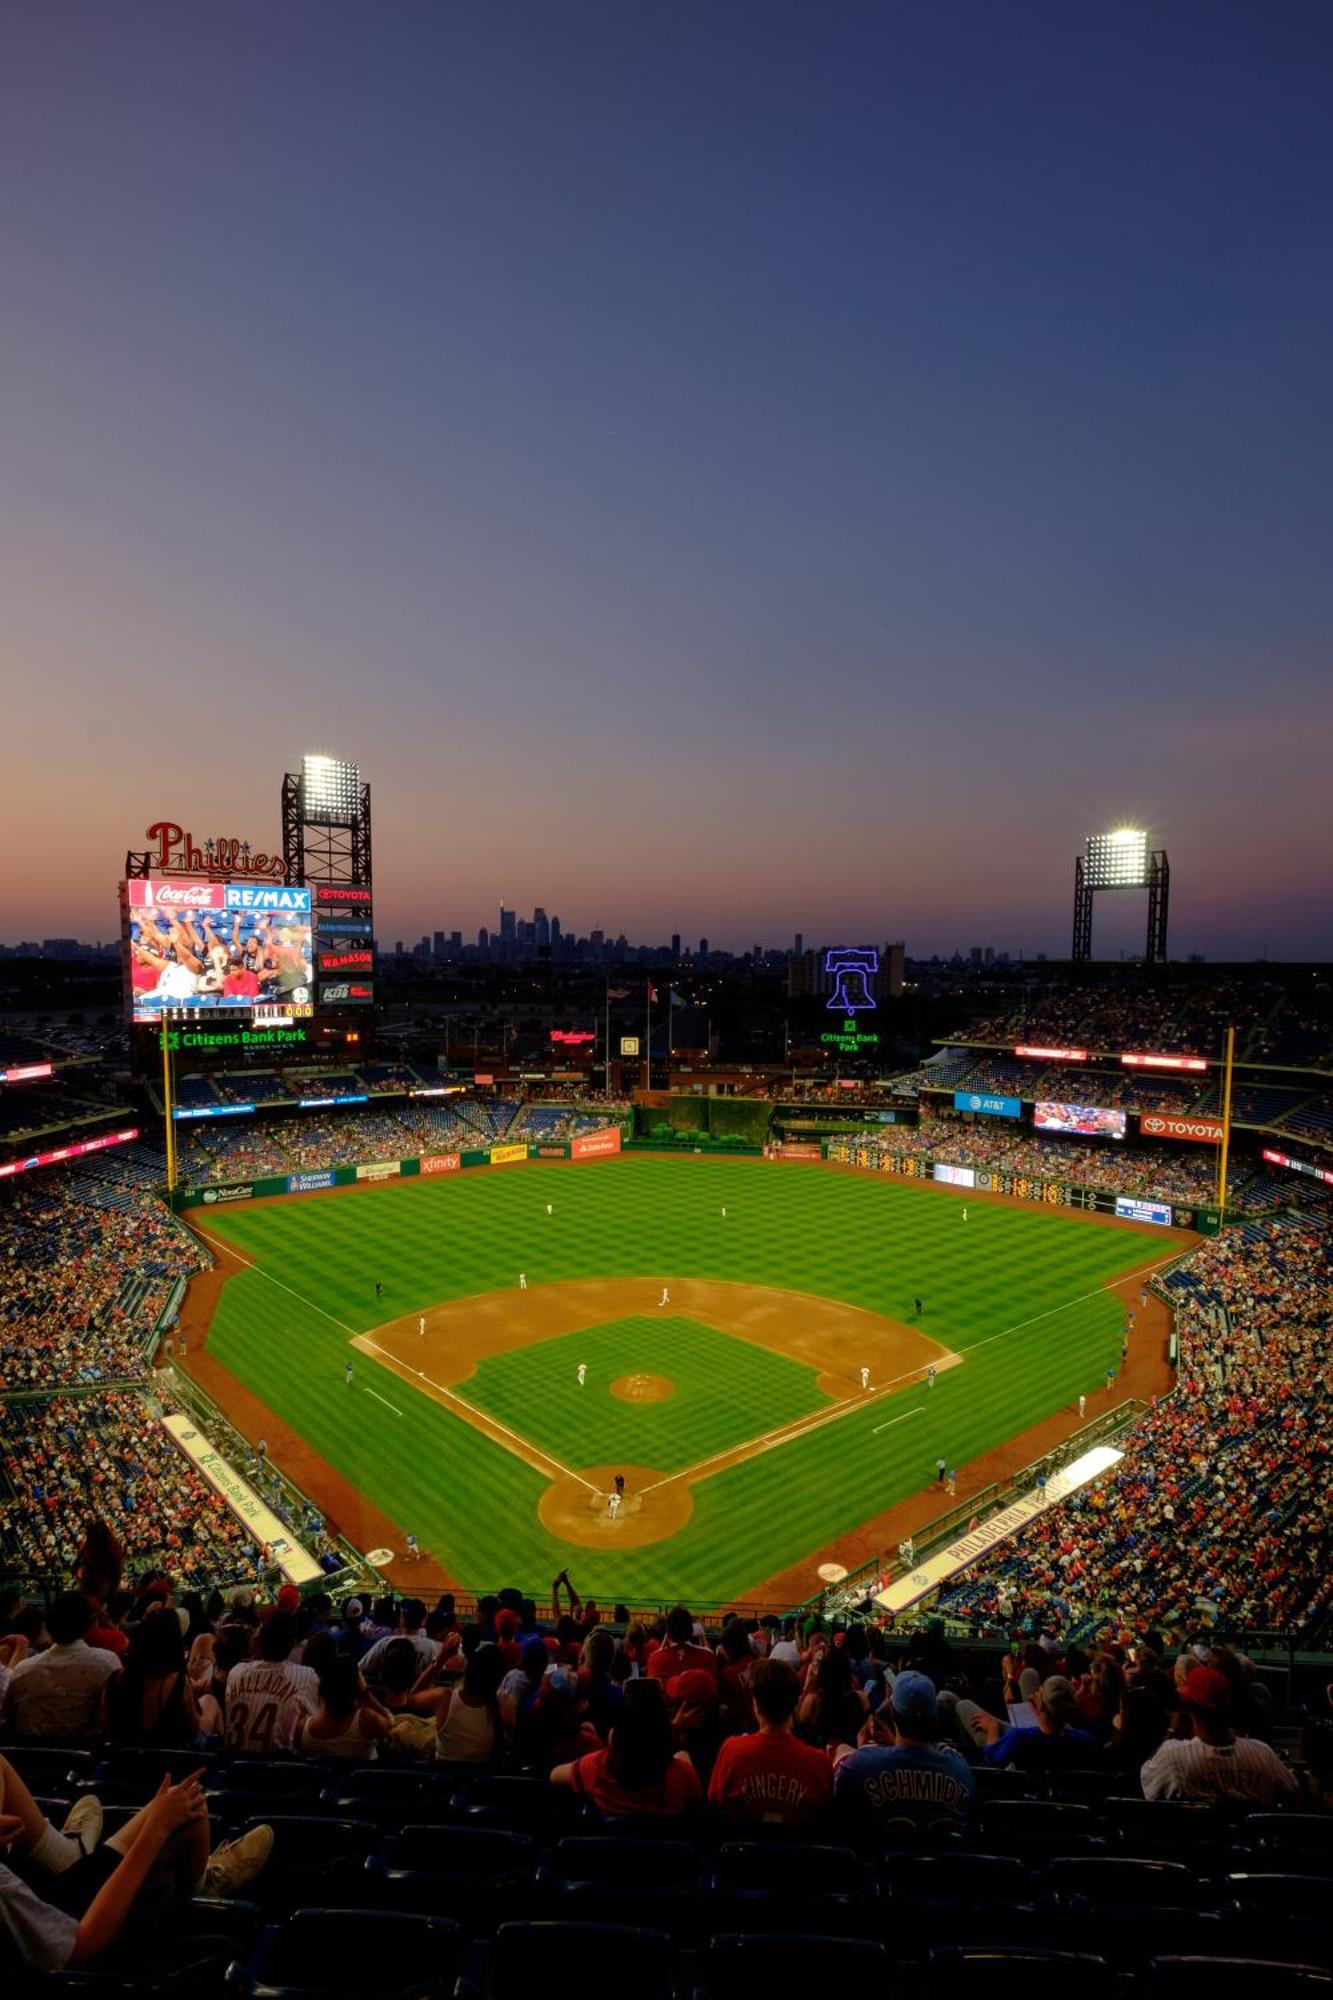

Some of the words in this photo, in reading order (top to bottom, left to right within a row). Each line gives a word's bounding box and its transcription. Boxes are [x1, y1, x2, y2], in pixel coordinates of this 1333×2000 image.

[146, 822, 288, 876] Phillies
[156, 885, 214, 905] Coca-Cola
[227, 889, 308, 908] RE/MAX
[333, 890, 370, 900] TOYOTA
[183, 1033, 239, 1046] Citizens
[242, 1030, 275, 1044] Bank
[277, 1029, 306, 1042] Park
[821, 1033, 855, 1041] Citizens
[857, 1033, 879, 1042] Bank
[840, 1043, 859, 1051] Park
[984, 1100, 1004, 1110] AT&T
[1167, 1121, 1223, 1138] TOYOTA
[422, 1156, 457, 1173] xfinity
[228, 1485, 248, 1506] Bank
[241, 1501, 261, 1518] Park
[946, 1508, 1029, 1561] PHILADELPHIA
[231, 1674, 298, 1702] HALLADAY
[226, 1703, 277, 1753] 34
